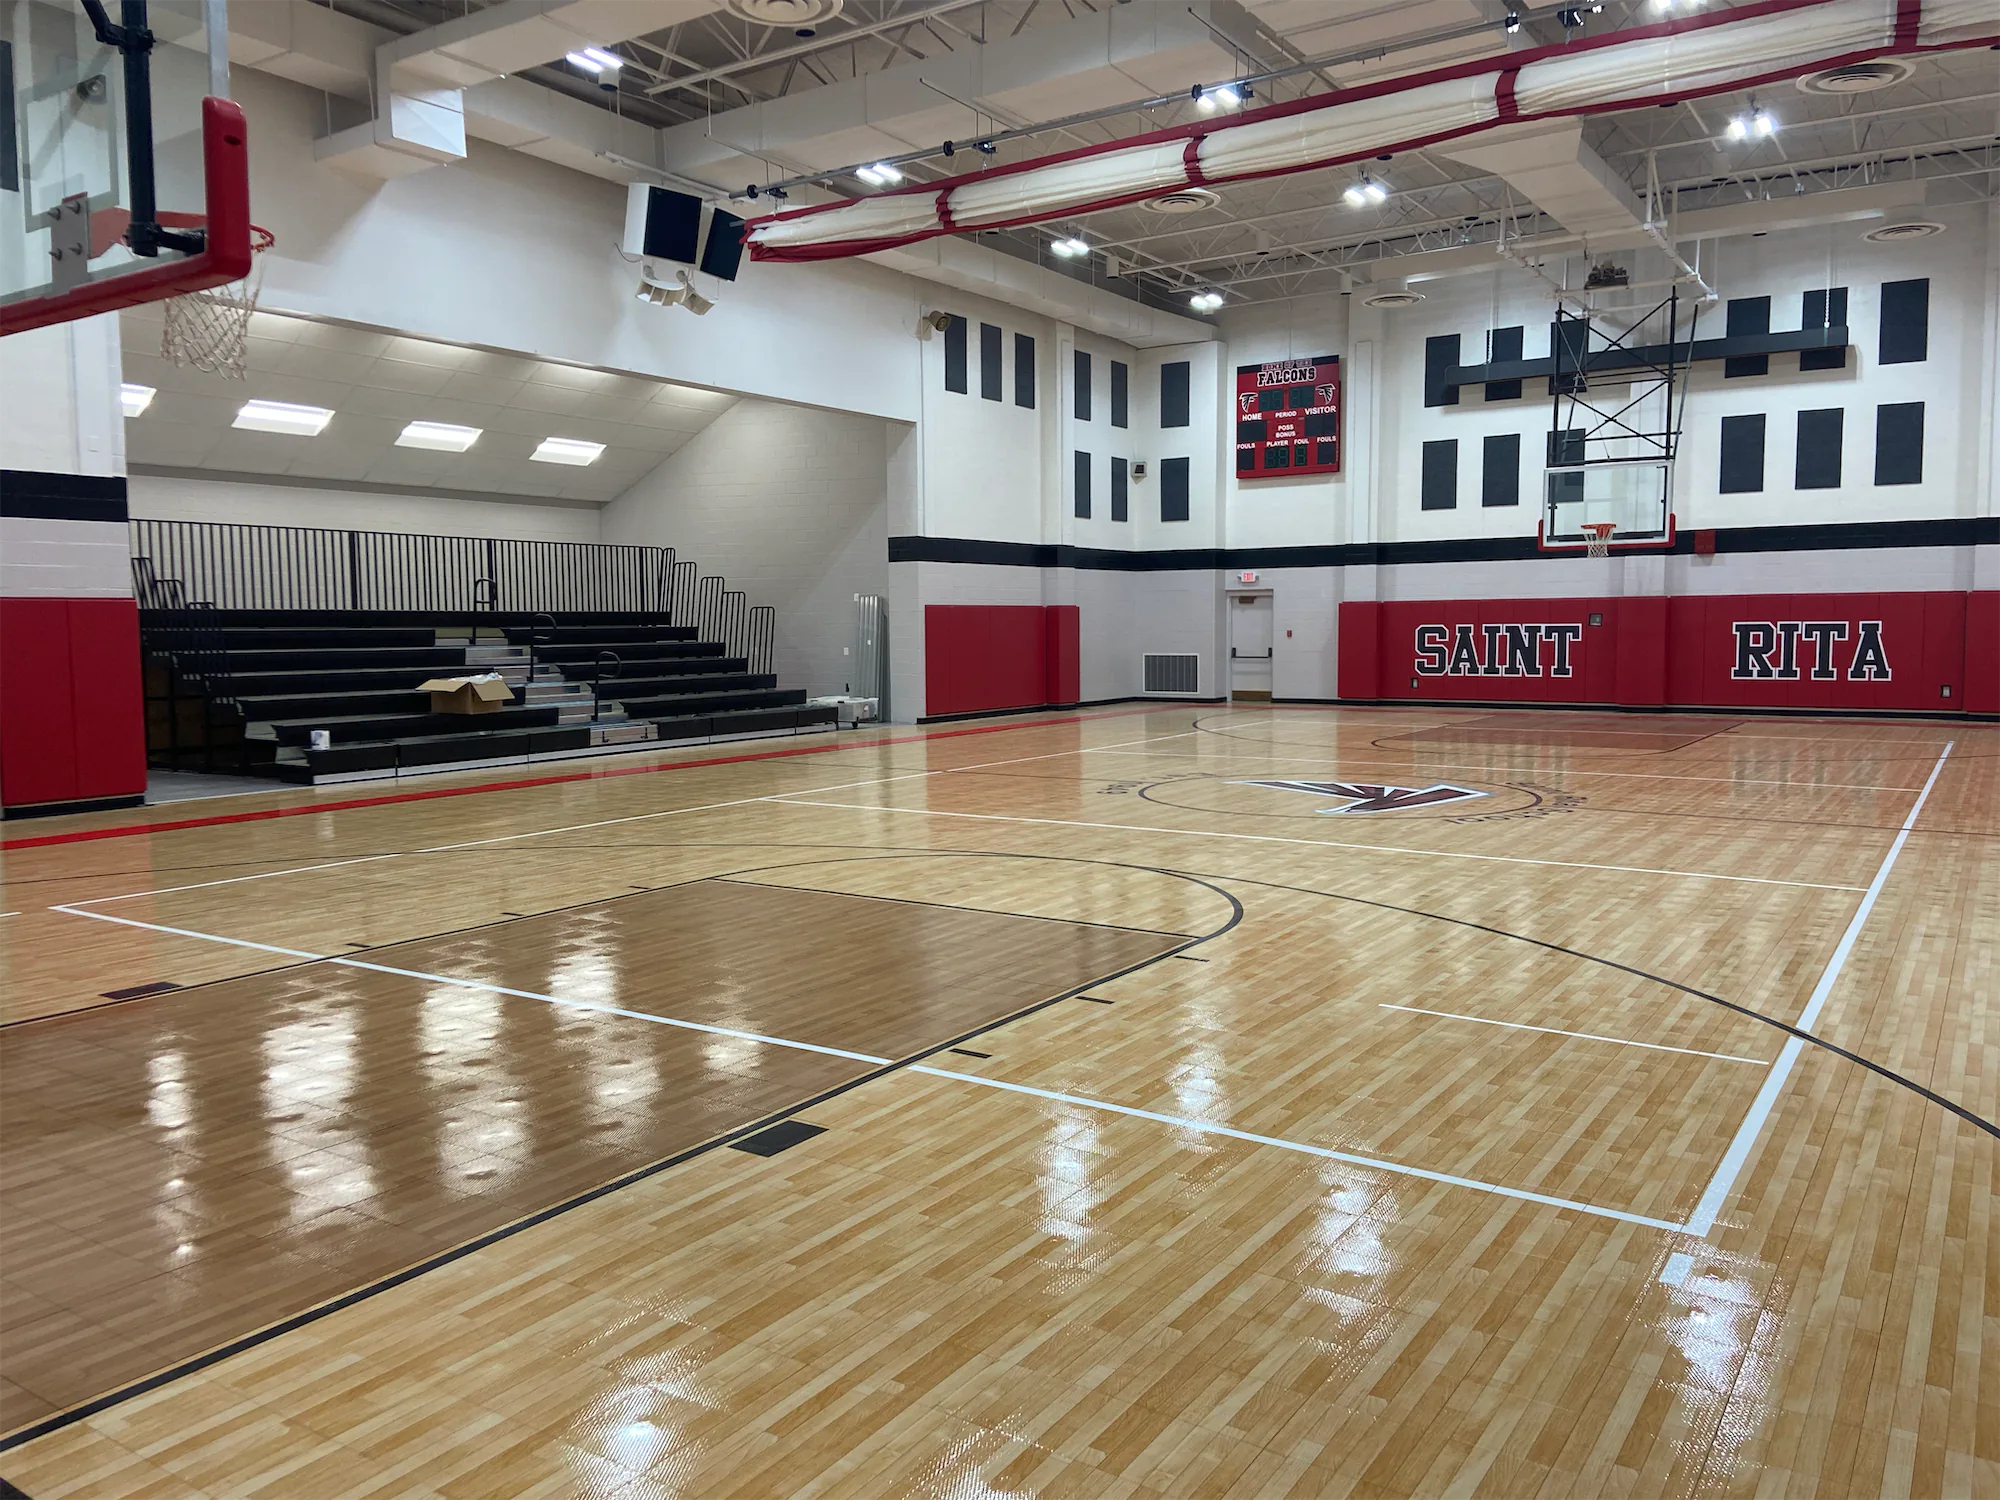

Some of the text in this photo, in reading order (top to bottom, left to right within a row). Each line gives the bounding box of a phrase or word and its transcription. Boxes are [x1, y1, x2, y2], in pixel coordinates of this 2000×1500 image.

[1257, 366, 1316, 387] FALCONS
[1242, 413, 1262, 421] HOME
[1304, 405, 1336, 415] VISITOR
[1414, 621, 1892, 680] SAINT RITA
